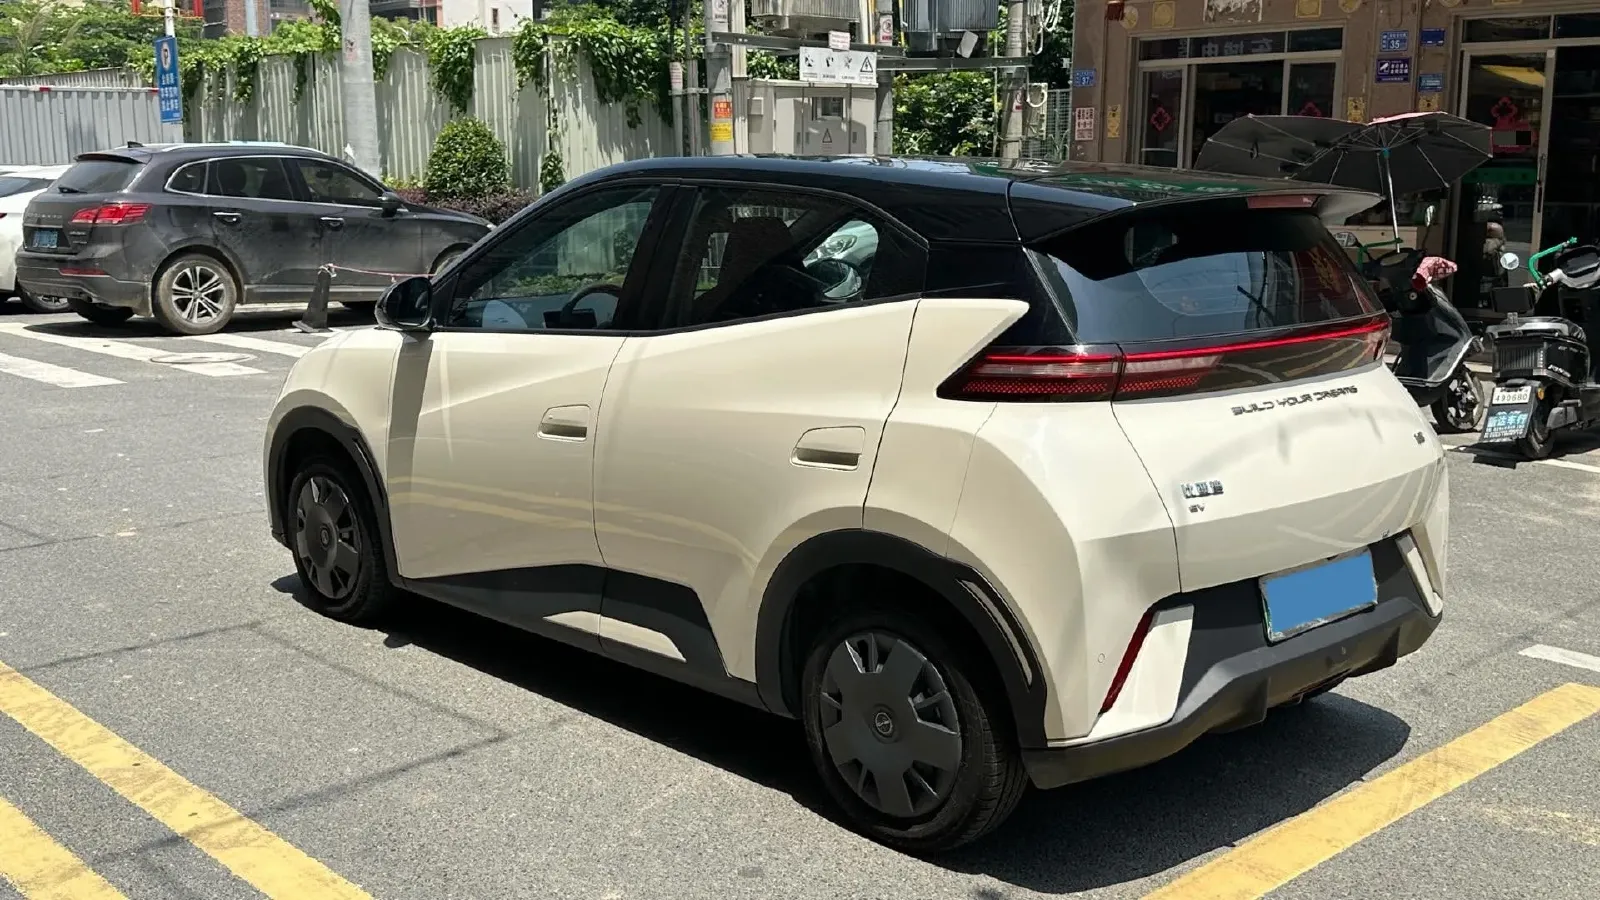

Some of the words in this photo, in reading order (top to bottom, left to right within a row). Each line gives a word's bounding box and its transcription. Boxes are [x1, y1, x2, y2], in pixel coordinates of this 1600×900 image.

[1389, 39, 1400, 49] 35
[1231, 401, 1275, 416] BUILD
[1276, 393, 1313, 408] YOUR
[1313, 385, 1358, 402] DREAMS
